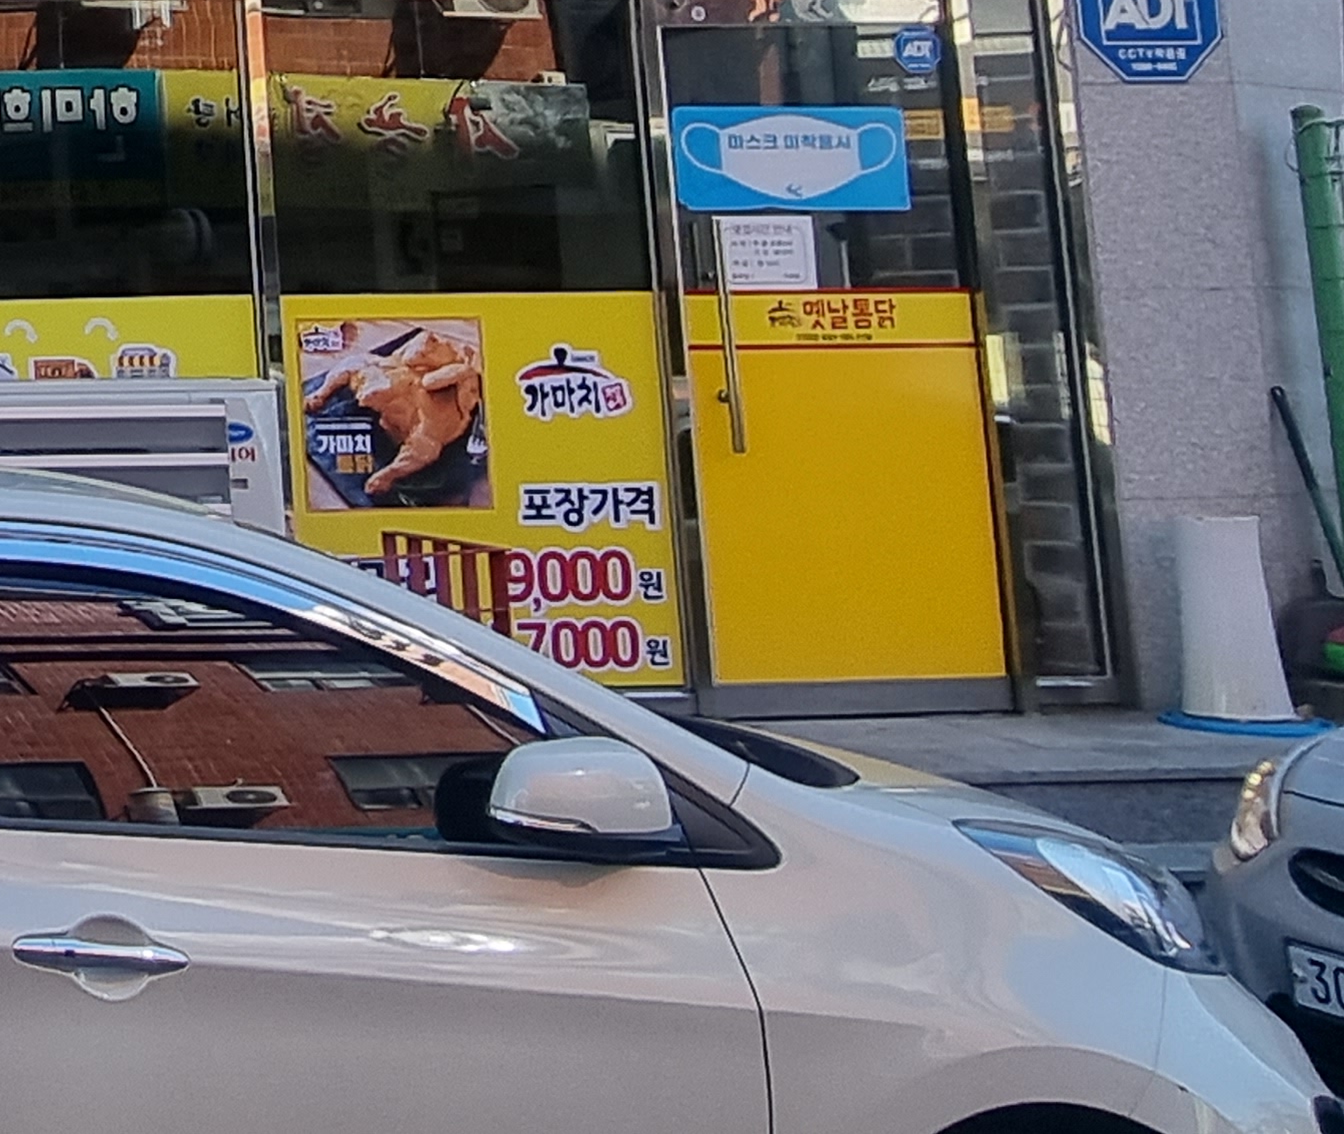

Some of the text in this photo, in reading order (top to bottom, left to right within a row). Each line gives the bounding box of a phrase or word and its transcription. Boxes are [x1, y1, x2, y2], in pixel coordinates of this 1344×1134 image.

[727, 133, 779, 151] 마스크
[802, 298, 897, 330] 옛날통닭
[523, 376, 601, 417] 가마치
[317, 434, 372, 454] 가마치
[521, 485, 657, 527] 포장가격
[505, 549, 665, 613] 9,000 원
[645, 638, 671, 666] 원
